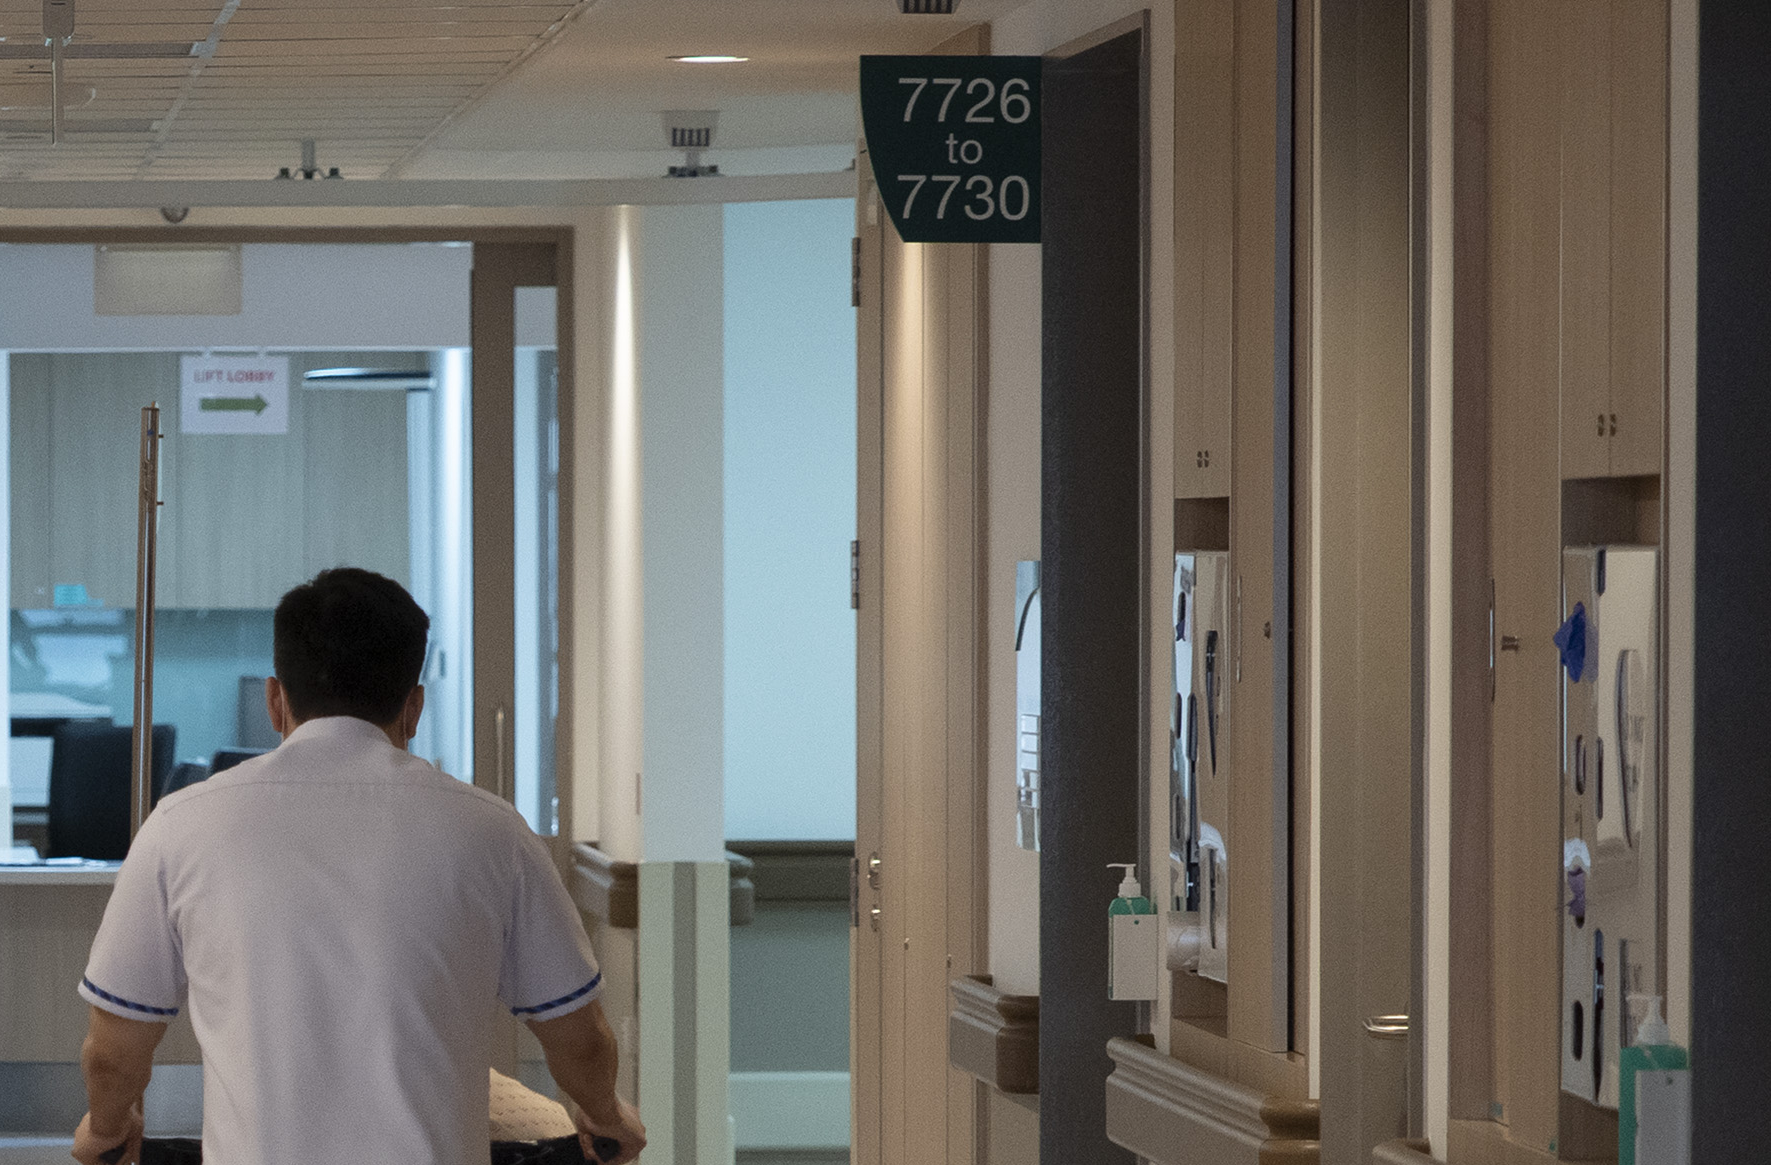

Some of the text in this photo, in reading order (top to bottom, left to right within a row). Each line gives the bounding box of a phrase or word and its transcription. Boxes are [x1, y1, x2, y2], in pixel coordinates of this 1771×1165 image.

[898, 77, 1031, 124] 7726
[945, 133, 984, 165] to
[897, 174, 1030, 221] 7730
[193, 369, 275, 384] LIFT LOBBY
